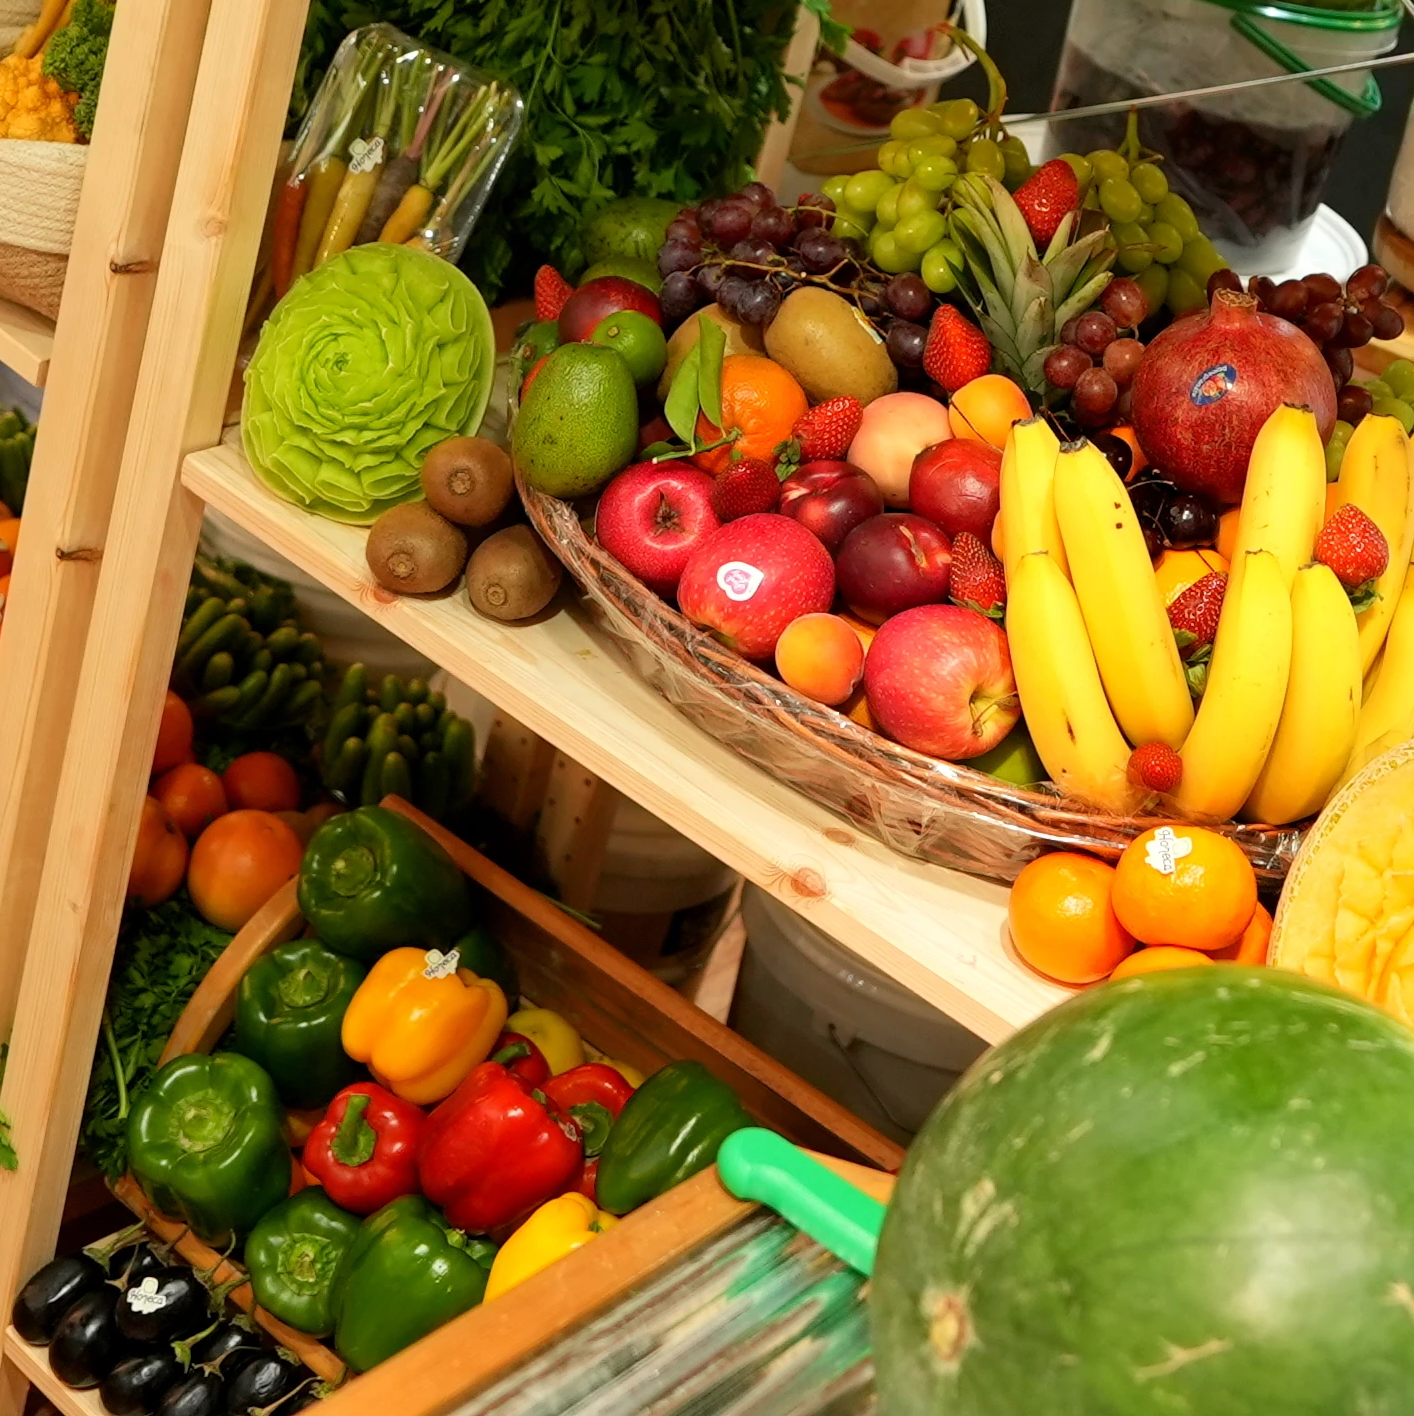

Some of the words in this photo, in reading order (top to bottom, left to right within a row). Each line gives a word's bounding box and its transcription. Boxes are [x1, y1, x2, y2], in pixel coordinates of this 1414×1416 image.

[351, 139, 382, 172] Horeca
[1158, 829, 1173, 872] Horeca
[424, 951, 458, 978] Horeca
[129, 1288, 164, 1306] Horeca
